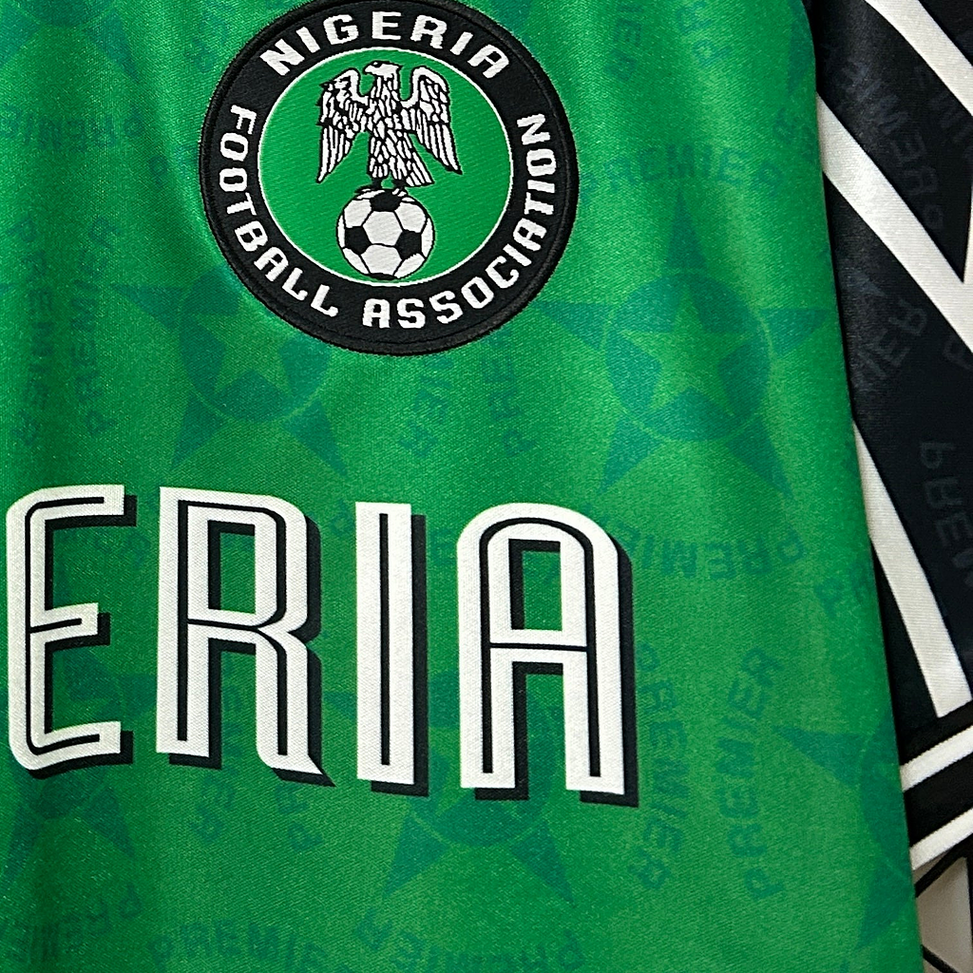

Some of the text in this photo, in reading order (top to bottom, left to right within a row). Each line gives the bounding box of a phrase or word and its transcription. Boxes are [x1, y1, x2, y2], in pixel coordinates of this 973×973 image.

[259, 10, 511, 79] NIGERIA
[70, 214, 124, 436] PREMIER
[218, 104, 557, 330] FOOTBALL ASSOCIATION
[716, 645, 784, 900] PREMIER
